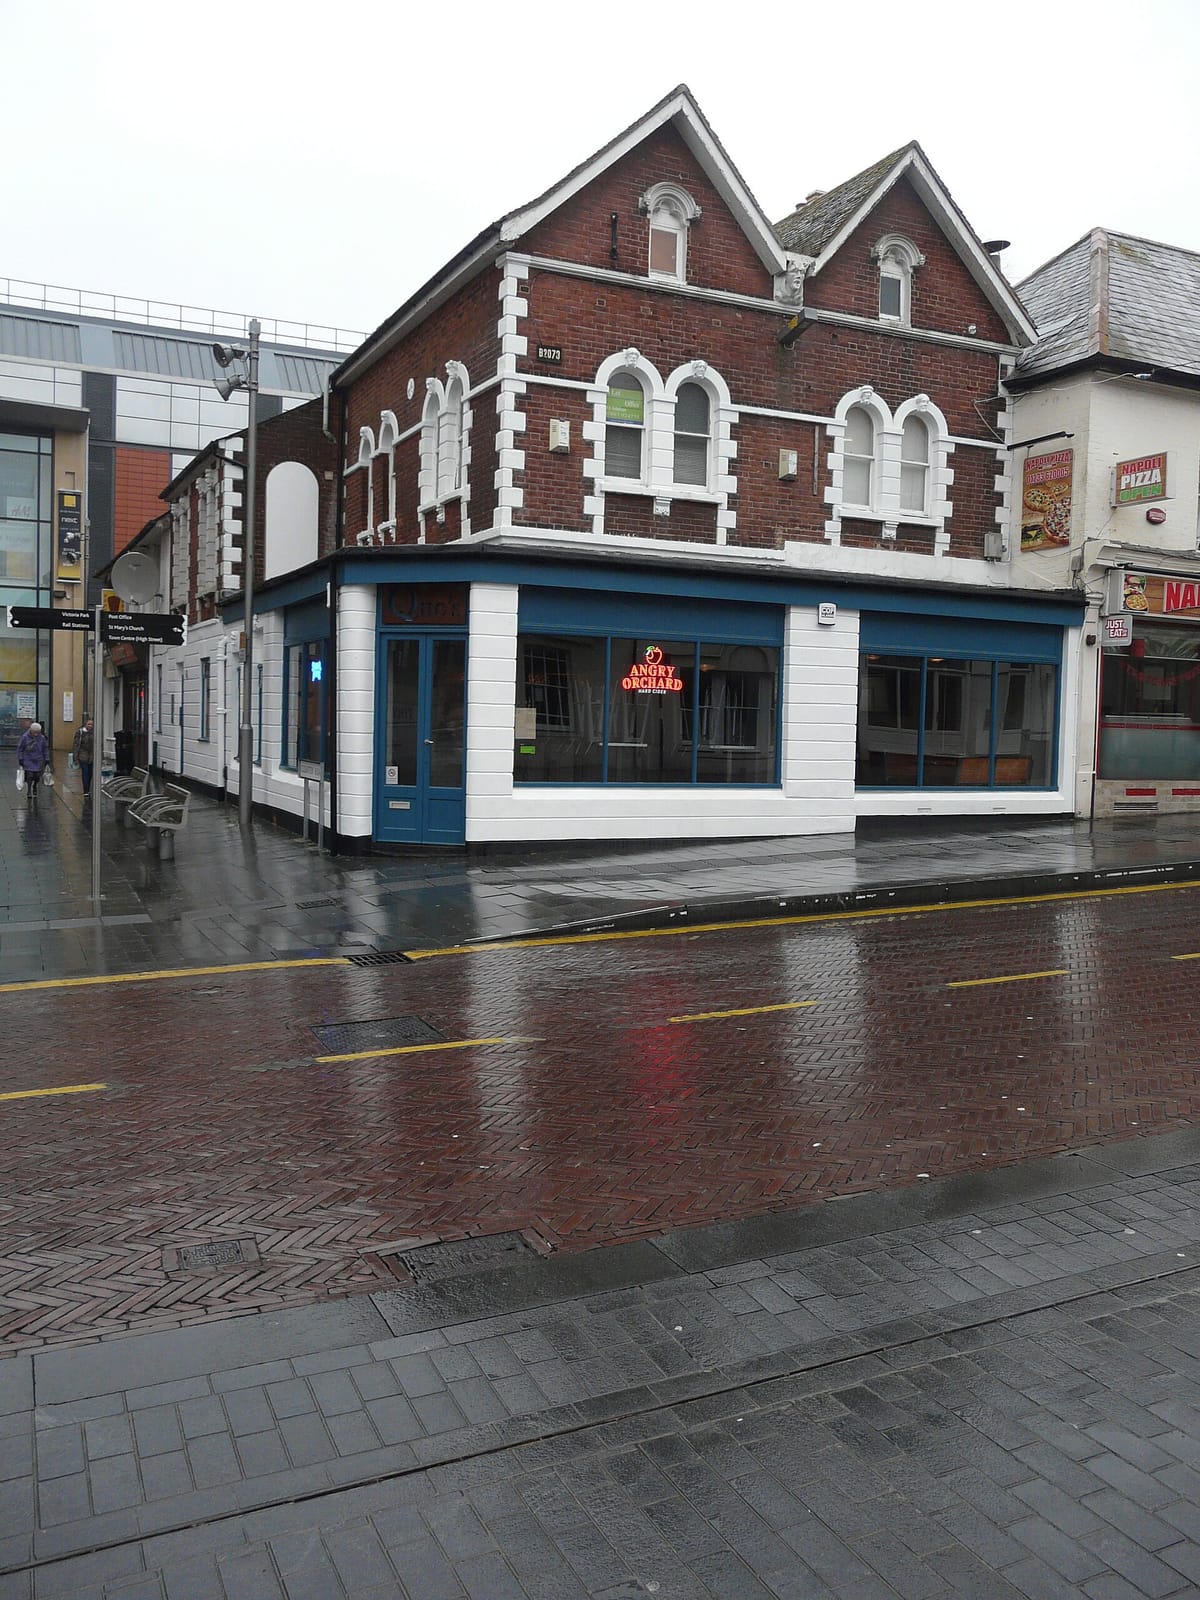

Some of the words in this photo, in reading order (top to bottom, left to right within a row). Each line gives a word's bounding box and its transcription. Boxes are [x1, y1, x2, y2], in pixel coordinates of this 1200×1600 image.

[538, 348, 561, 360] B2073
[1121, 456, 1162, 475] NAPOLI
[1121, 469, 1162, 490] PIZZA
[1120, 483, 1162, 501] OPEN
[1163, 581, 1200, 614] NA
[1105, 619, 1124, 630] JUST
[1109, 629, 1122, 638] EAT
[629, 664, 676, 677] ANGRY
[622, 676, 683, 691] ORCHARD
